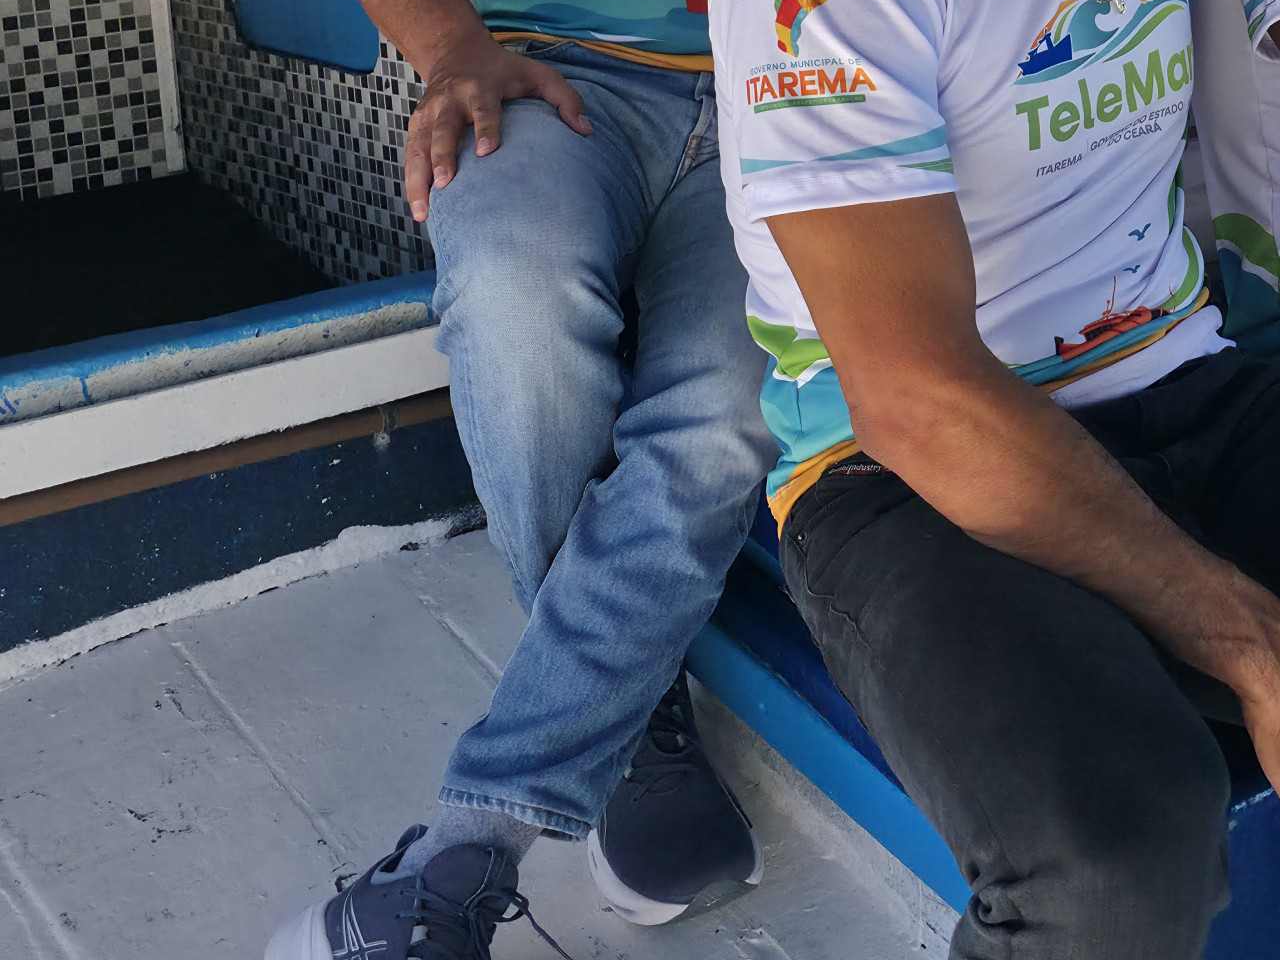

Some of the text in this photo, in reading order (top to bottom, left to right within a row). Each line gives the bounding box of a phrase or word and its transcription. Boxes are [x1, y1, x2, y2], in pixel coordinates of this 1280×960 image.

[750, 58, 862, 76] GOVERNO MUNICIPAL DE
[746, 67, 877, 105] ITAREMA
[1132, 114, 1147, 127] DO
[1148, 101, 1184, 121] ESTADO
[1107, 120, 1162, 148] DO CEARÁ
[1036, 153, 1083, 178] ITAREMA
